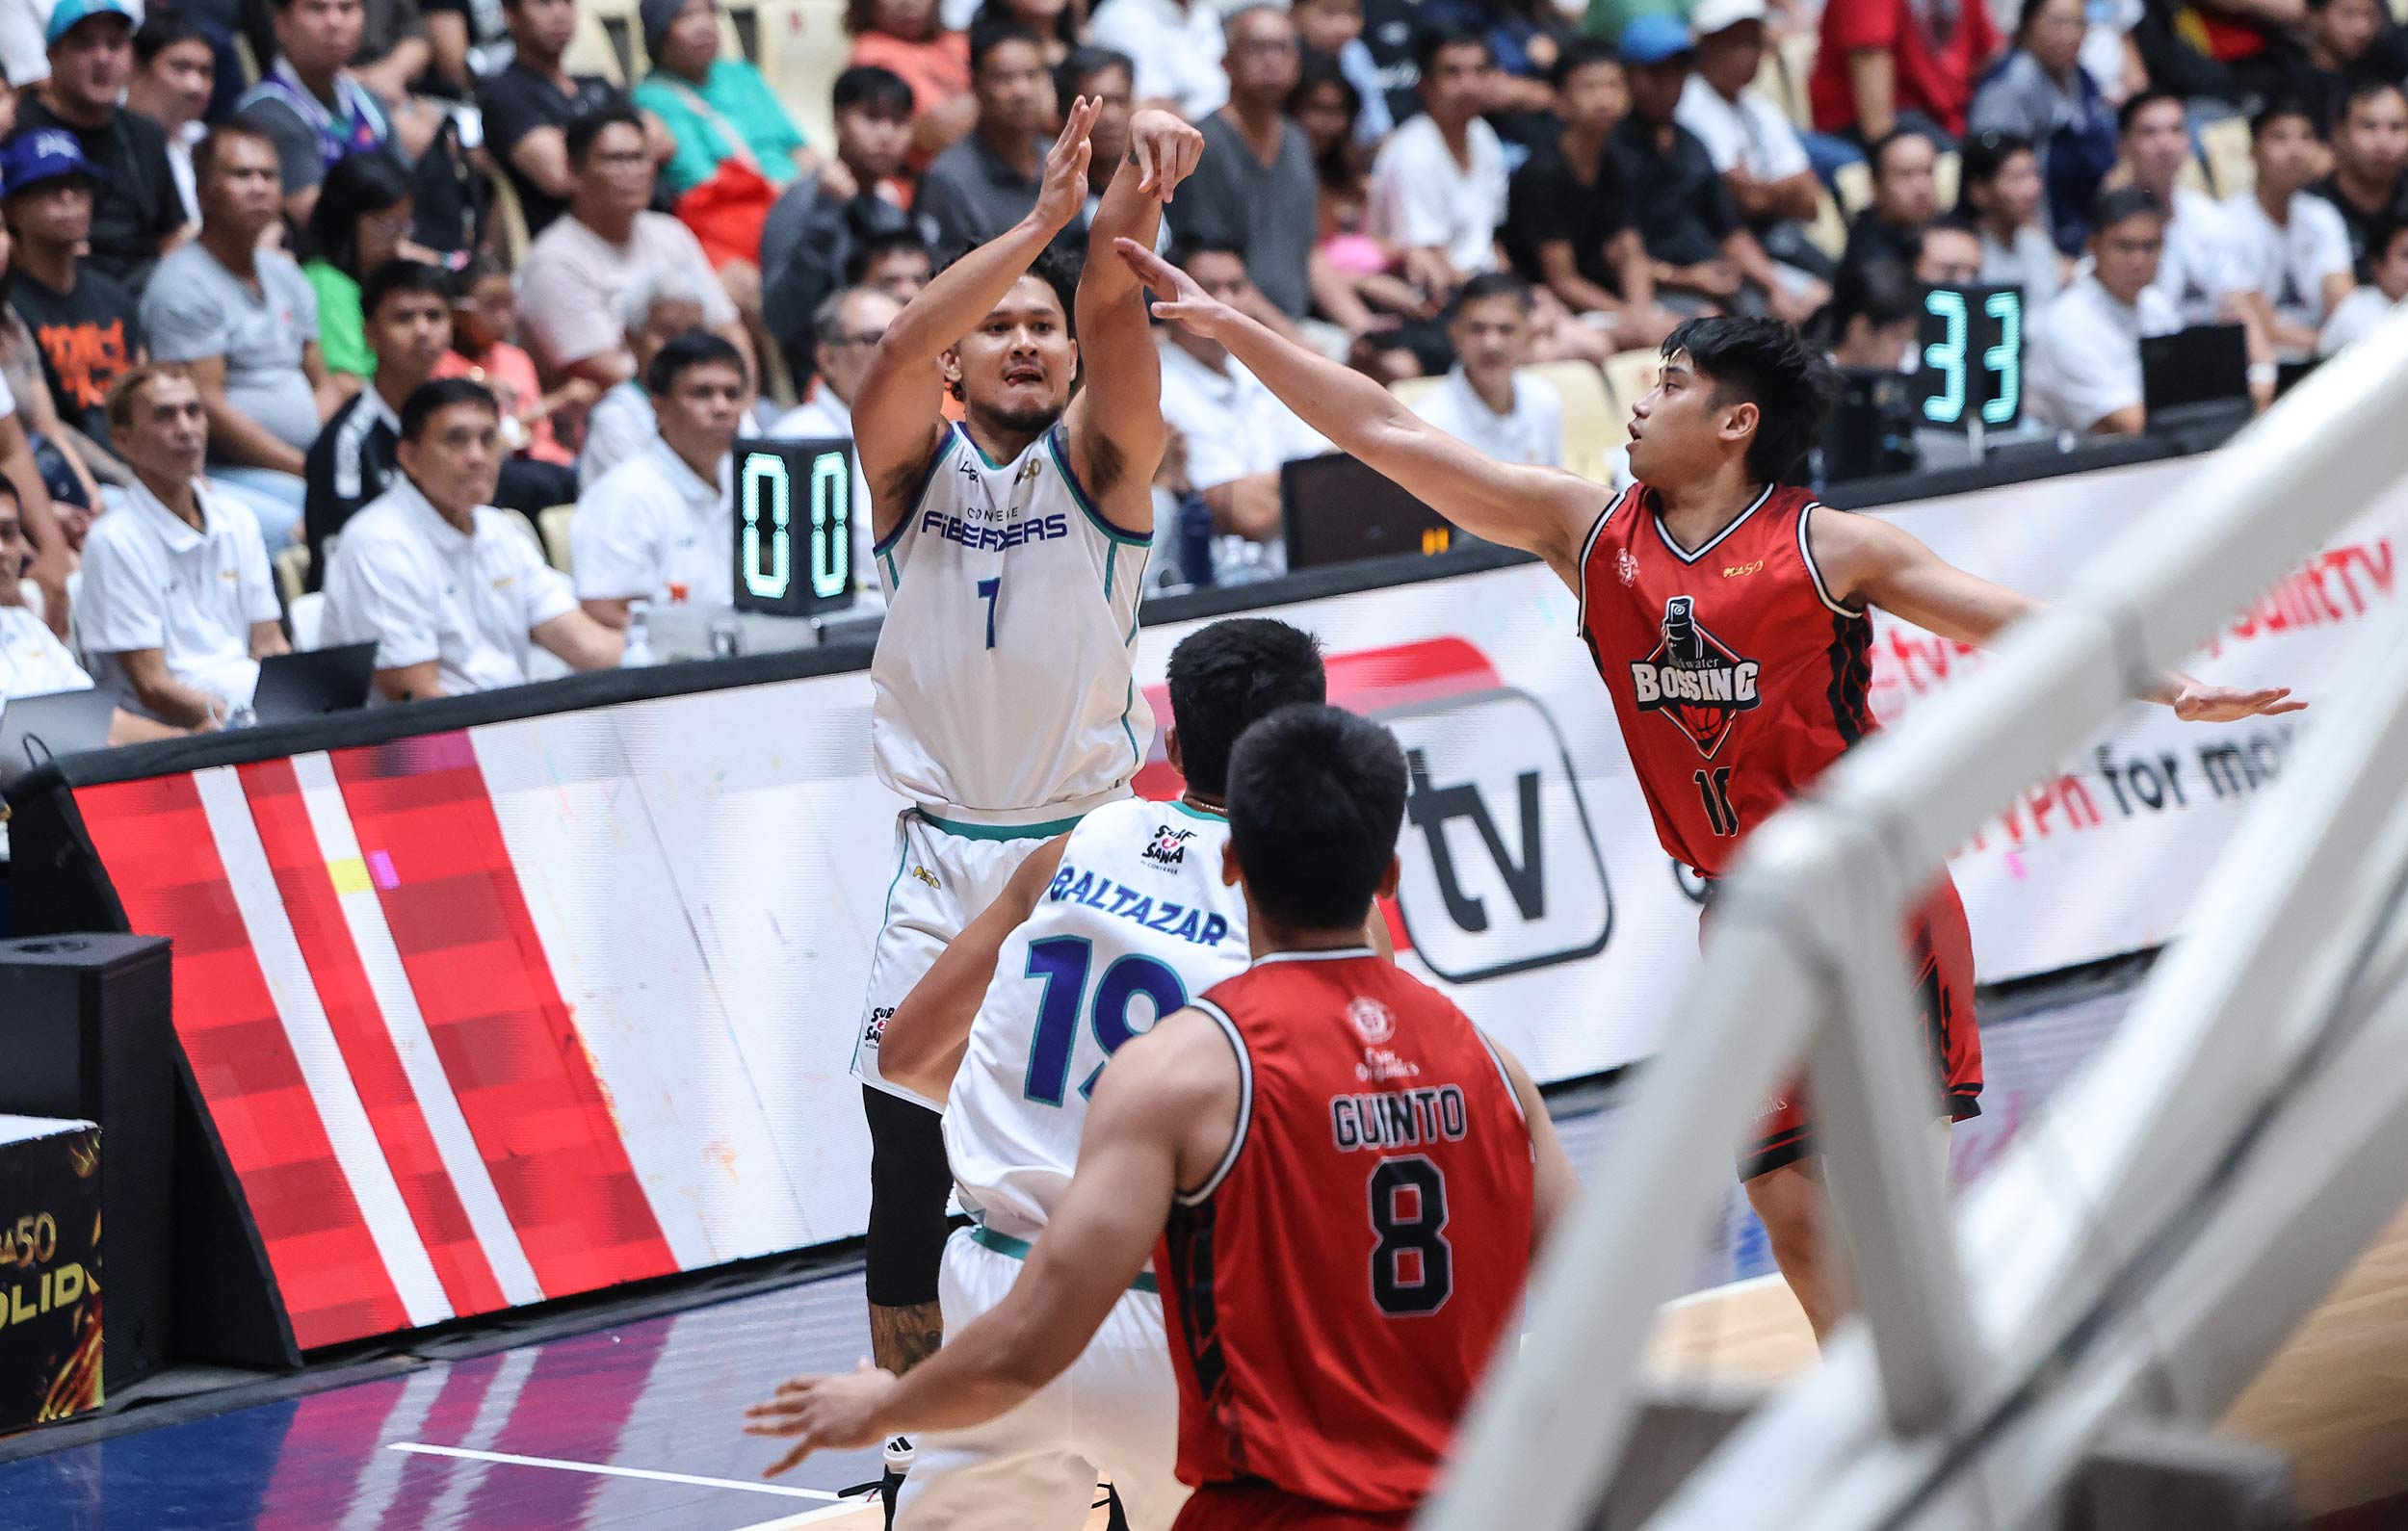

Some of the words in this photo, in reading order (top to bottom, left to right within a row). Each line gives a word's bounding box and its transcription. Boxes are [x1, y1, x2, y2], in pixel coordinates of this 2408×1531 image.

[1923, 290, 2021, 424] 33
[743, 452, 849, 599] 00
[1631, 662, 1760, 702] BOSSING
[2096, 743, 2192, 818] for
[1050, 865, 1228, 947] BALTAZAR
[1024, 934, 1191, 1108] 19
[1329, 1083, 1468, 1153] GUINTO
[1366, 1154, 1453, 1318] 8
